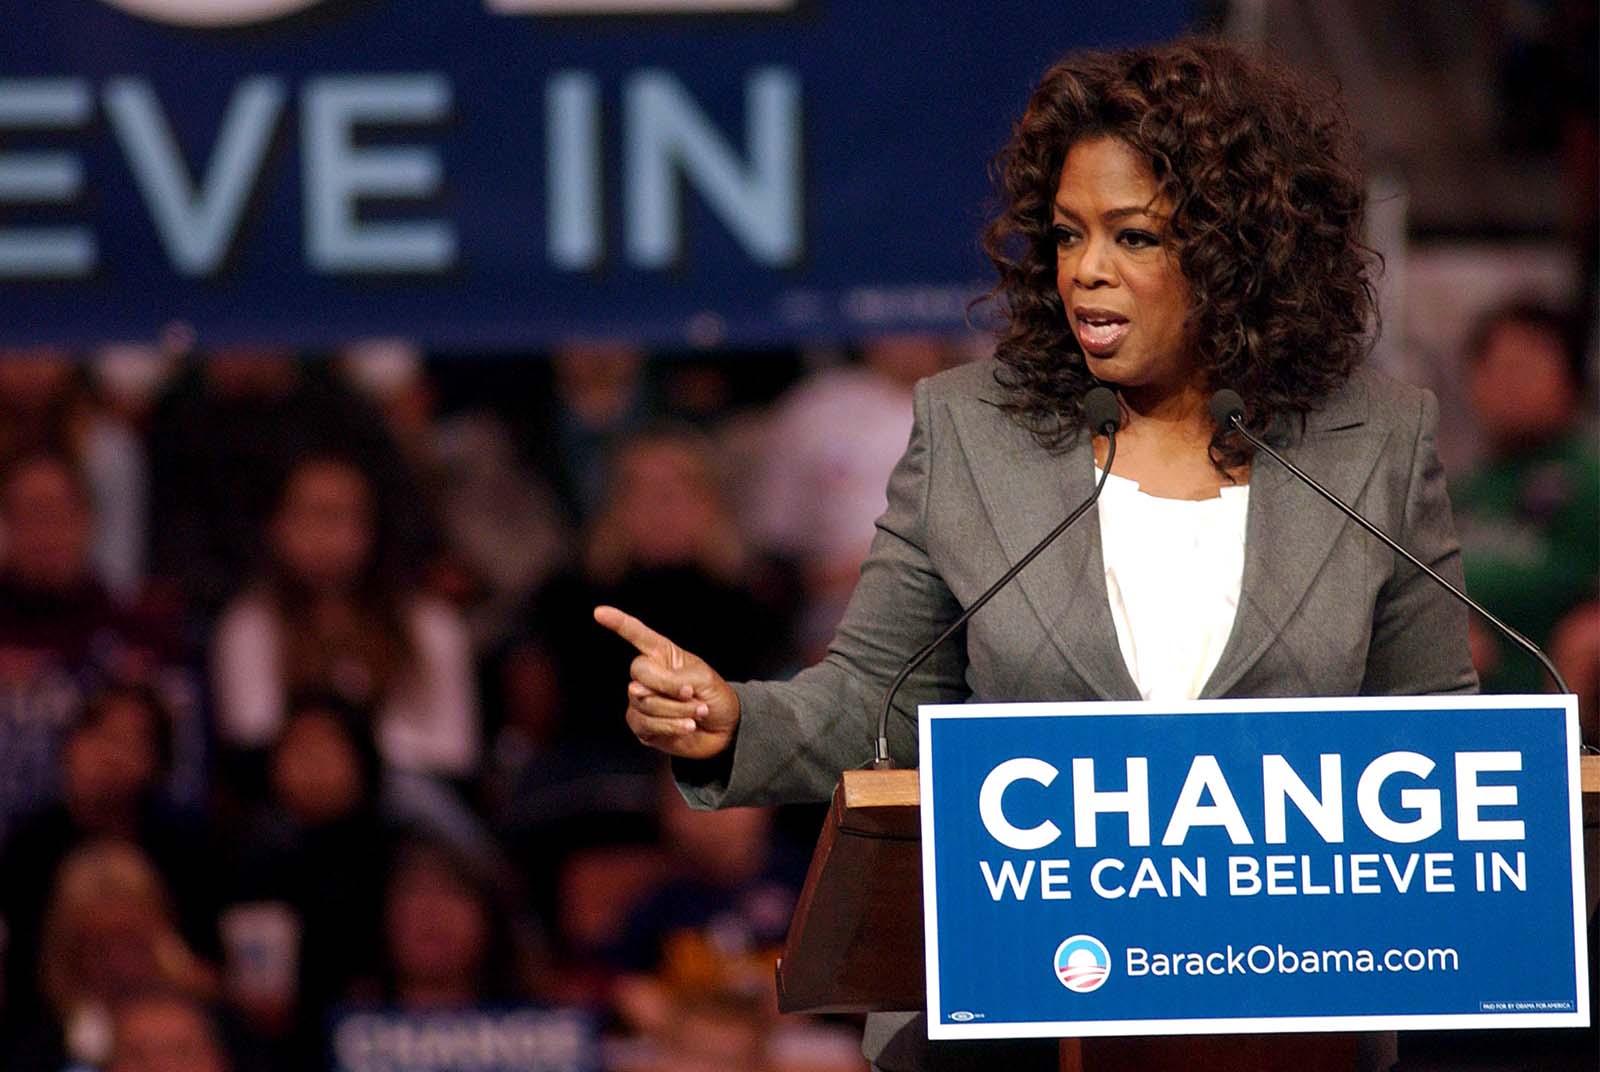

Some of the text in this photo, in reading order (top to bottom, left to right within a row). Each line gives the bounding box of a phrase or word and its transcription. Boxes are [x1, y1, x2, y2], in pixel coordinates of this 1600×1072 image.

[550, 71, 798, 267] IN
[980, 752, 1525, 850] CHANGE
[979, 852, 1527, 901] WE CAN BELIEVE IN
[1126, 944, 1459, 976] BarackObama.com
